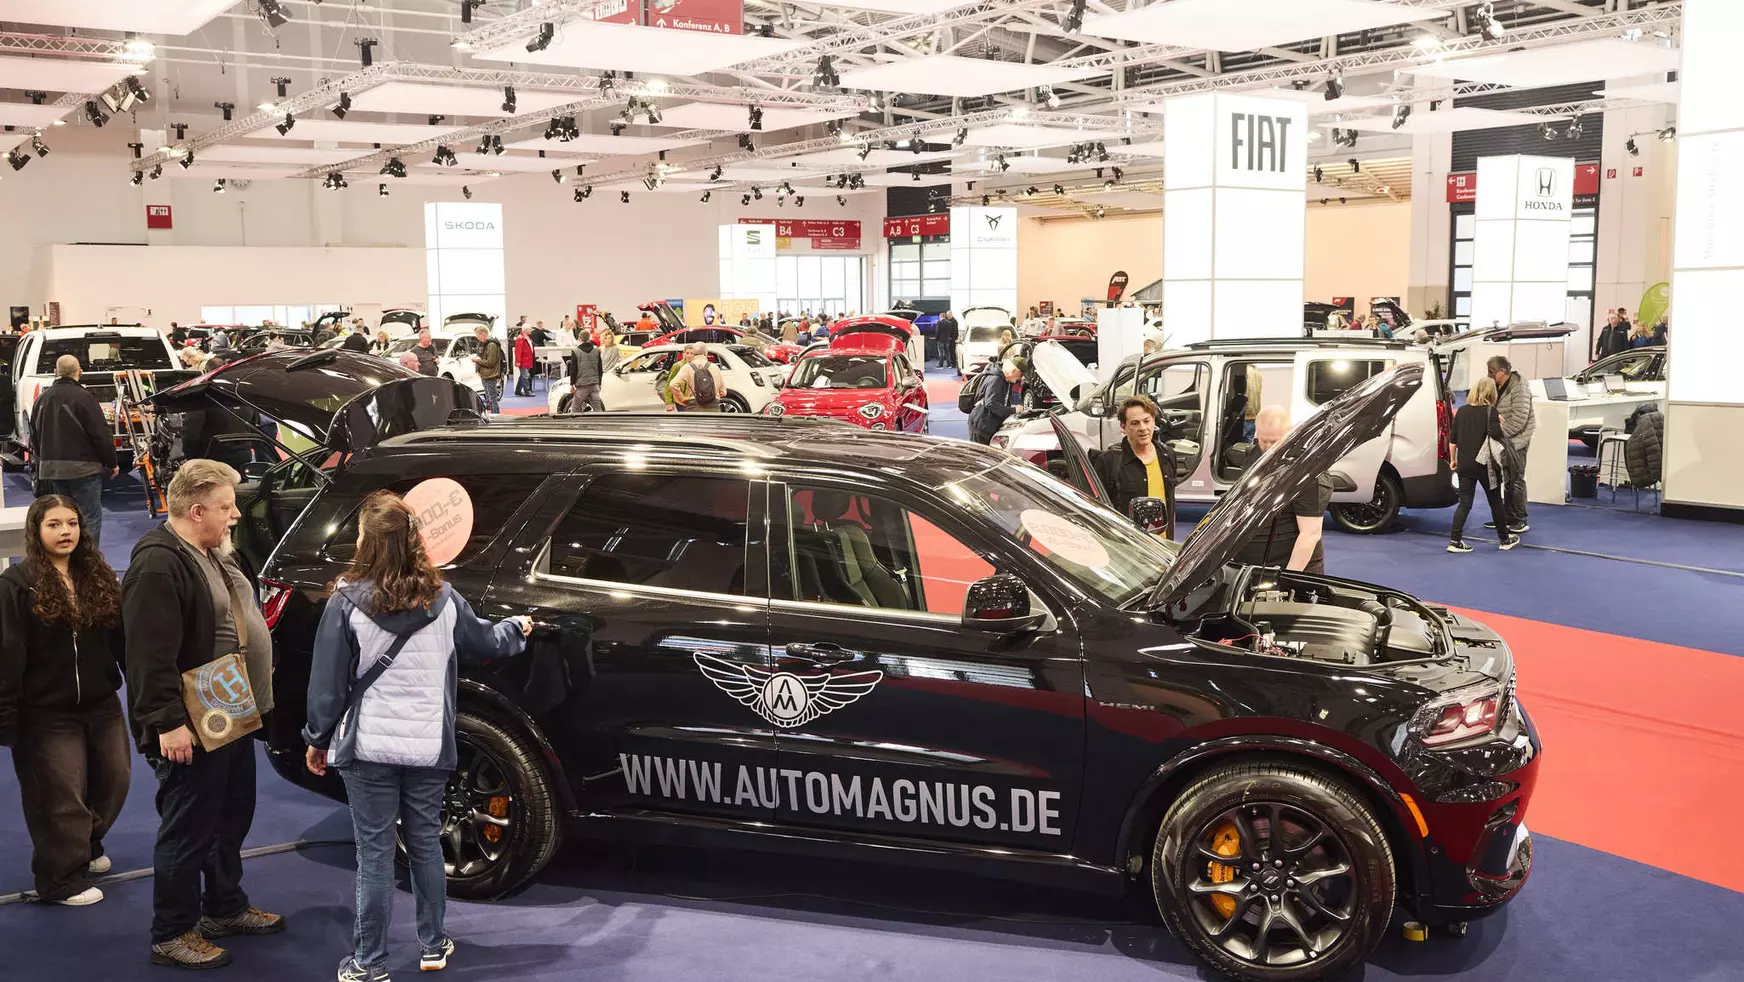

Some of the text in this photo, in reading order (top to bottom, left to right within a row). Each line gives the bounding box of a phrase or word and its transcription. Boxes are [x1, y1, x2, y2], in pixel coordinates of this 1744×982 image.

[673, 19, 712, 31] Konferenz
[724, 24, 730, 32] B
[1232, 112, 1292, 172] FIAT
[1524, 200, 1563, 211] HONDA
[779, 226, 792, 236] B4
[832, 227, 845, 237] C3
[910, 224, 920, 234] C3
[213, 663, 248, 702] H
[619, 753, 1061, 835] WWW.AUTOMAGNUS.DE
